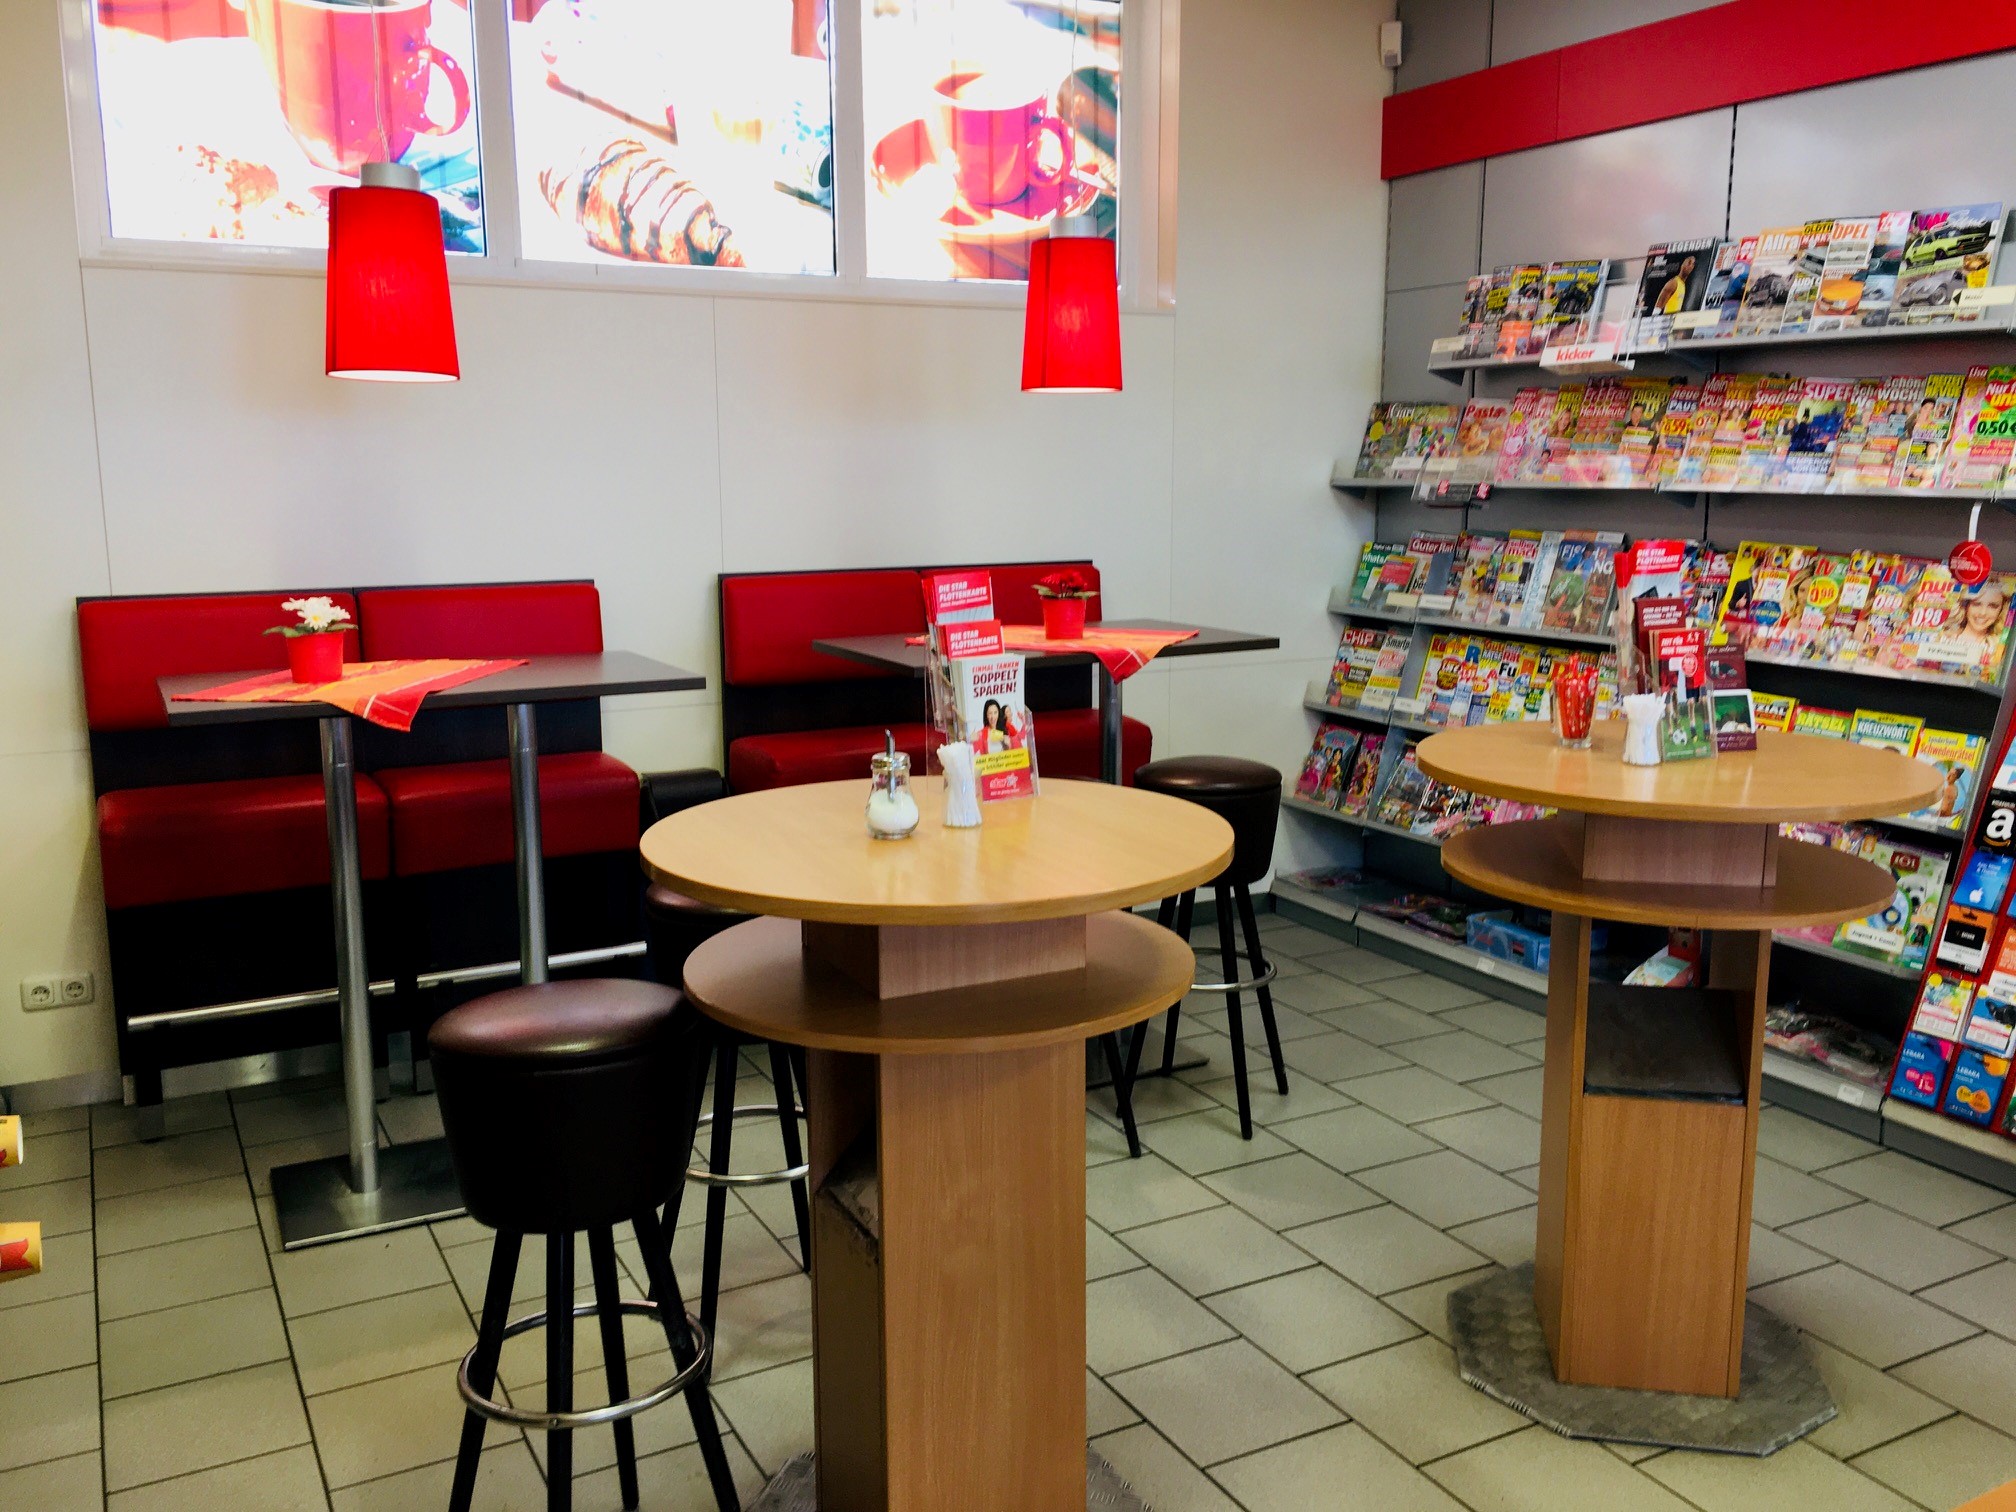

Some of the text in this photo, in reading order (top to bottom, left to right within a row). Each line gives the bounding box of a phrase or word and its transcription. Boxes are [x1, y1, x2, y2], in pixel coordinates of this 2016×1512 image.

[1556, 347, 1595, 361] kicker
[1465, 404, 1507, 420] Pasta
[1412, 539, 1438, 553] Guter
[938, 581, 968, 593] DIE STAR
[950, 629, 979, 641] DIE STAR
[1342, 630, 1375, 646] CHIP
[972, 661, 1019, 673] EINMAL TANKEN
[973, 669, 1018, 685] DOPPELT
[973, 682, 1017, 698] SPAREN!
[1921, 743, 1975, 761] Schwedenrätsel
[1986, 808, 2015, 841] a
